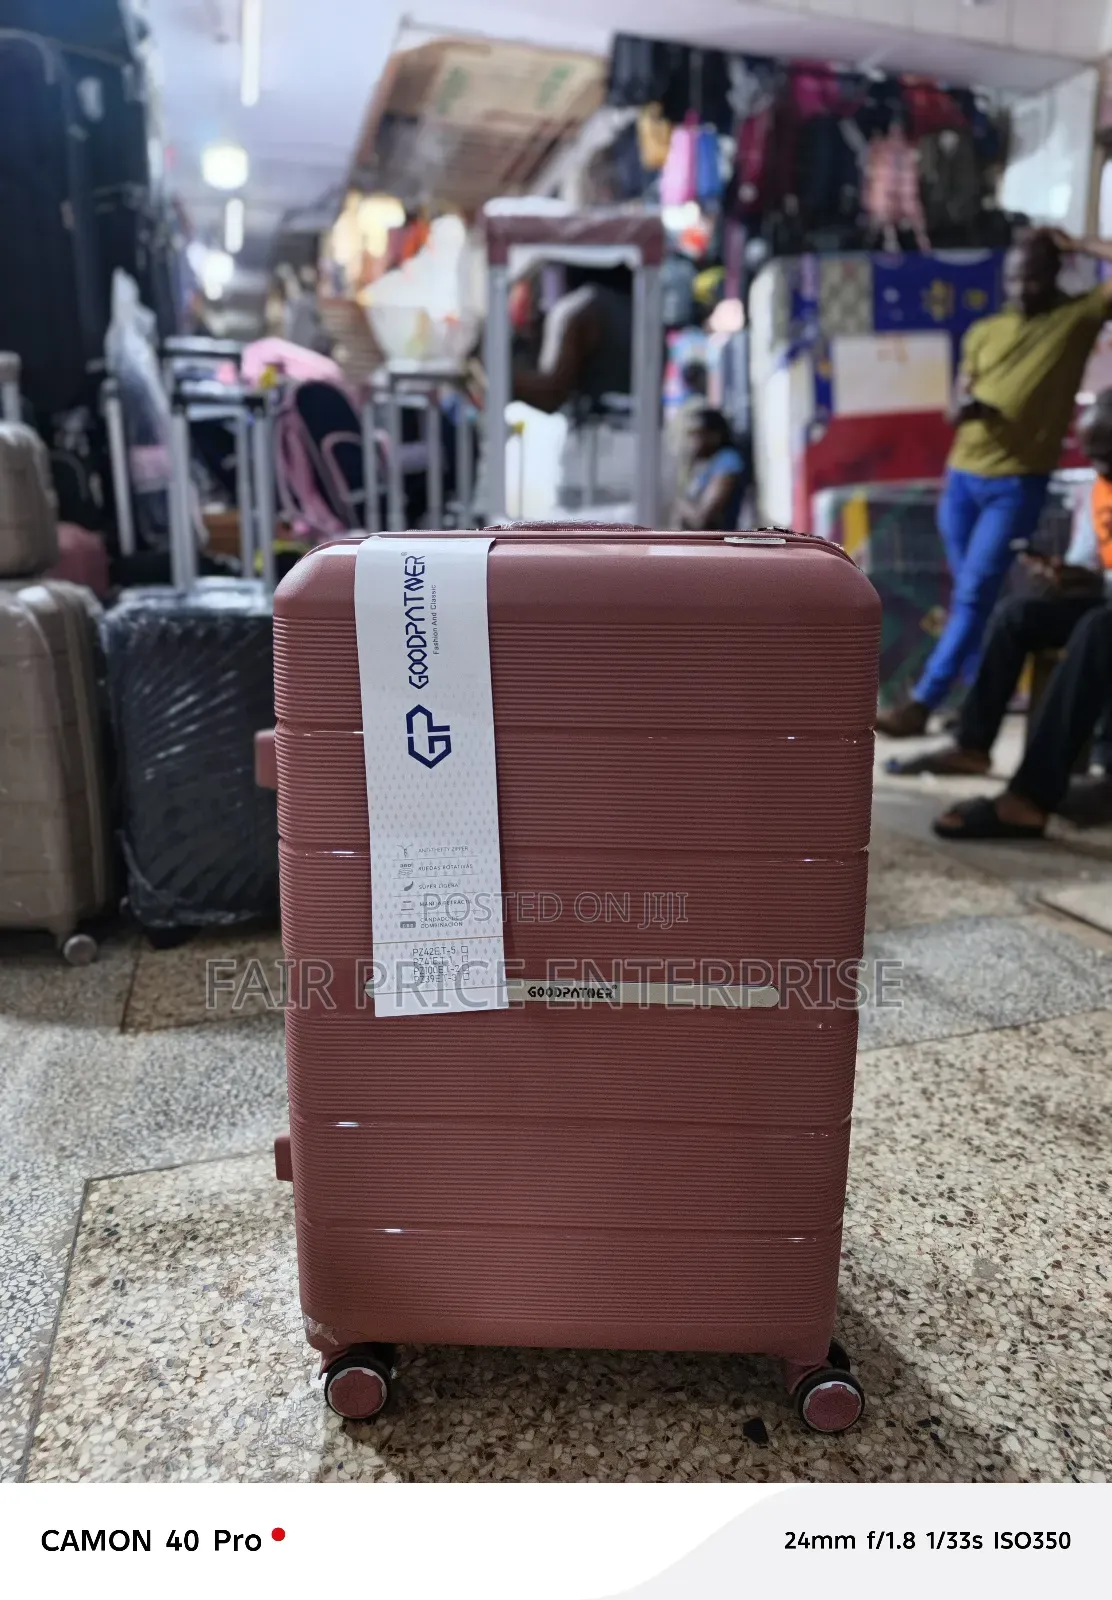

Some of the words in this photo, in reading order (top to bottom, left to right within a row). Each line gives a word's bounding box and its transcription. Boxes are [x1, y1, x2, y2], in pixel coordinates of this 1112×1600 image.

[429, 584, 437, 610] Classic
[430, 612, 438, 626] And
[431, 627, 440, 655] Fashion
[405, 704, 452, 769] GP
